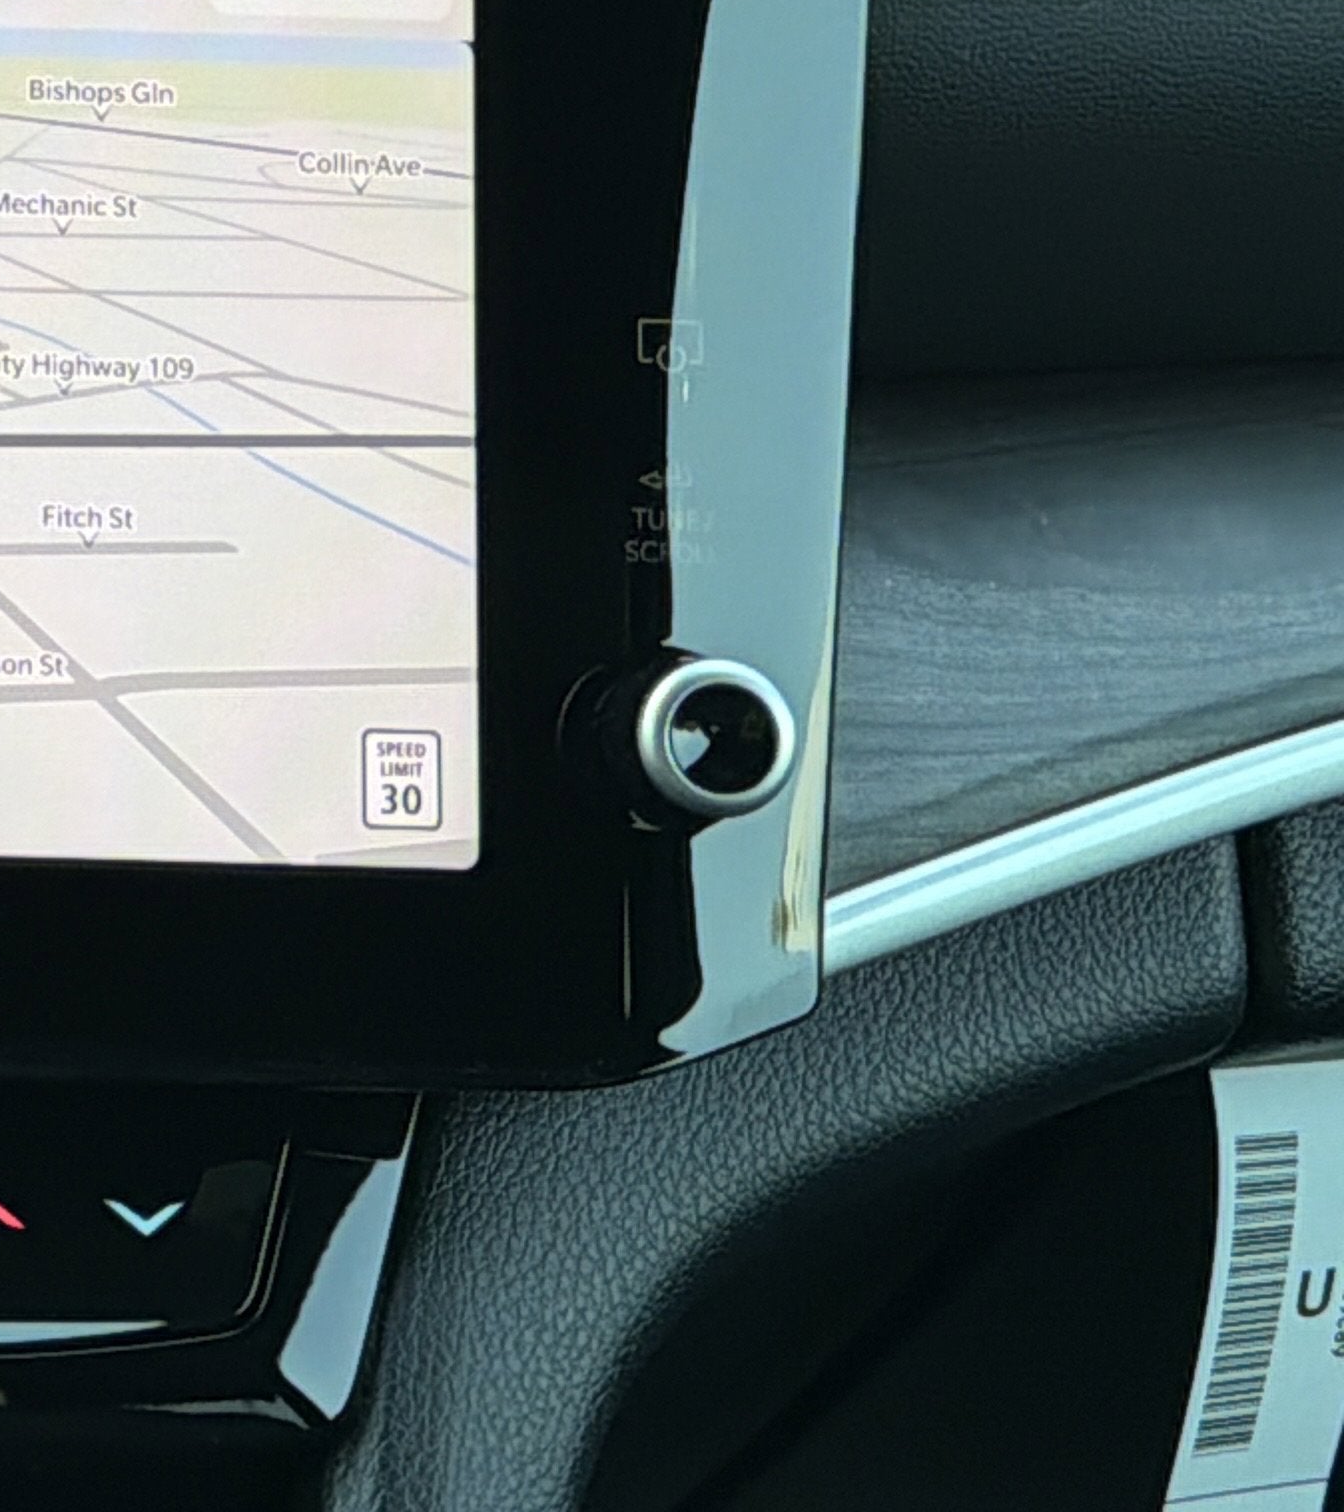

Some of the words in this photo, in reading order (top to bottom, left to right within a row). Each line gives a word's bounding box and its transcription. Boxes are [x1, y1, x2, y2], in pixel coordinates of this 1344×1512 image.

[29, 79, 126, 106] Bishops
[131, 83, 174, 105] Gln
[298, 151, 366, 175] Collin
[372, 155, 421, 177] Ave
[113, 195, 137, 218] St
[31, 354, 140, 383] Highway
[149, 356, 194, 380] 109
[42, 506, 102, 531] Fitch
[108, 507, 134, 531] St
[39, 654, 64, 679] St
[376, 742, 427, 758] SPEED
[380, 761, 423, 778] LIMIT
[380, 784, 422, 815] 30
